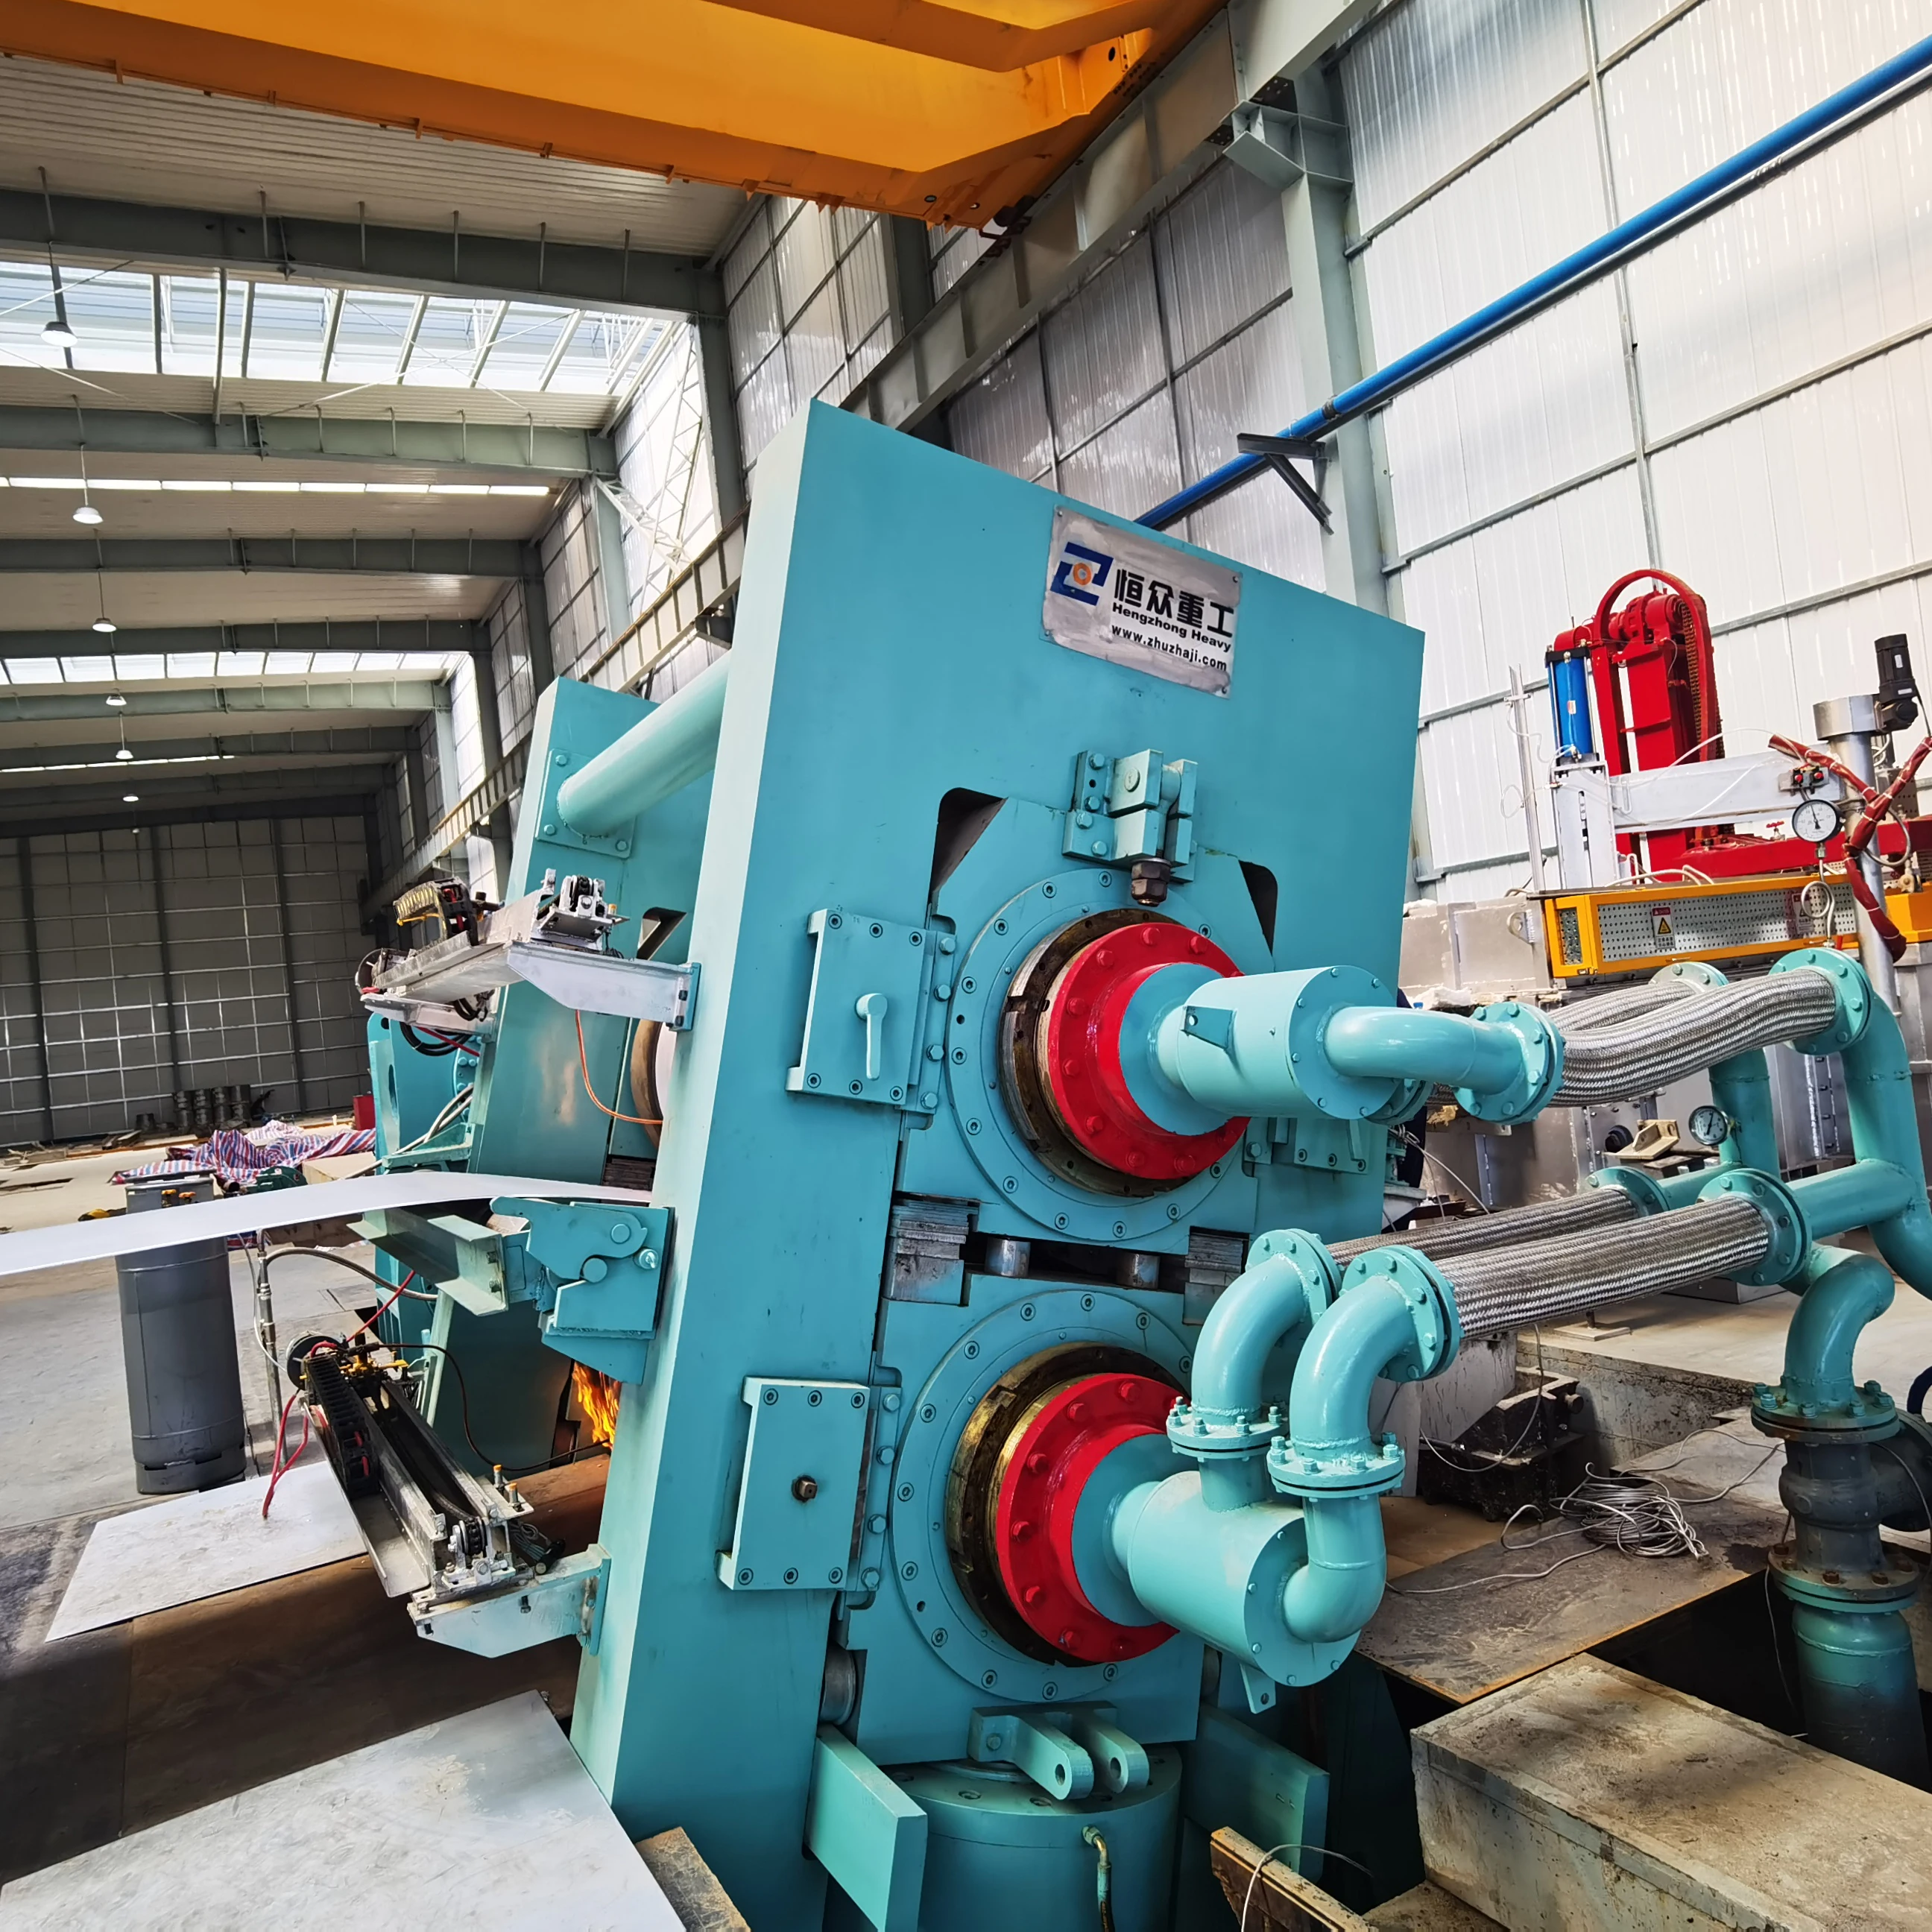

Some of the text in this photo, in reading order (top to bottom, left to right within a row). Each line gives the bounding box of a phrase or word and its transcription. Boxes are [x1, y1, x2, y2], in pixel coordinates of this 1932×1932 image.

[1112, 602, 1231, 652] Hengzhong Heavy
[1114, 569, 1234, 638] 恒众重工
[1111, 625, 1227, 671] www.zhuzhaji.com
